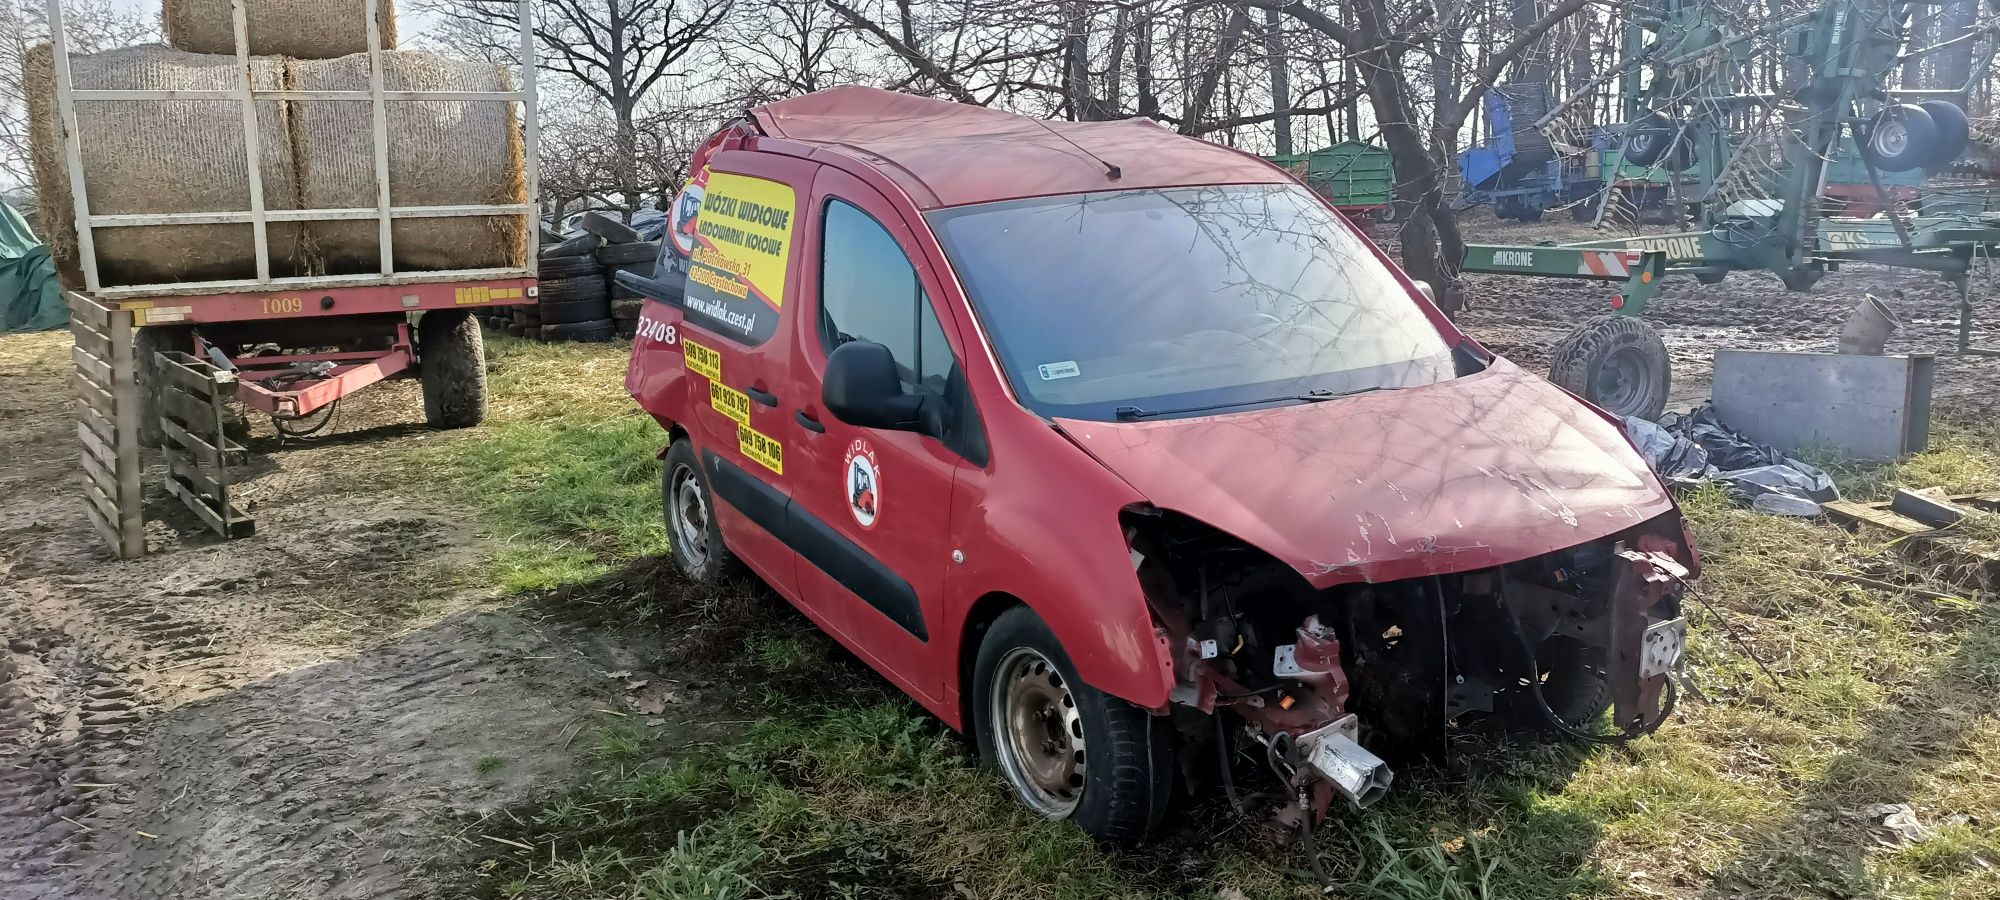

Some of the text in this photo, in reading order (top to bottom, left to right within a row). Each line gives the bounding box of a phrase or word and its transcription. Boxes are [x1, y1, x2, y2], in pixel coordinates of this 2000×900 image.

[704, 191, 790, 231] WÓZKI WIDŁOWE
[699, 220, 782, 257] ŁADOWARKI KOŁOWE
[1643, 236, 1704, 259] KRONE
[1502, 251, 1533, 267] KRONE
[689, 265, 748, 299] 42-200 Częstochowa
[260, 298, 303, 314] T009
[636, 315, 676, 345] 32408
[685, 341, 719, 370] 609 758 113
[711, 382, 748, 414] 661 926 792
[740, 426, 780, 462] 609 758 106
[845, 439, 880, 479] WIDLAK
